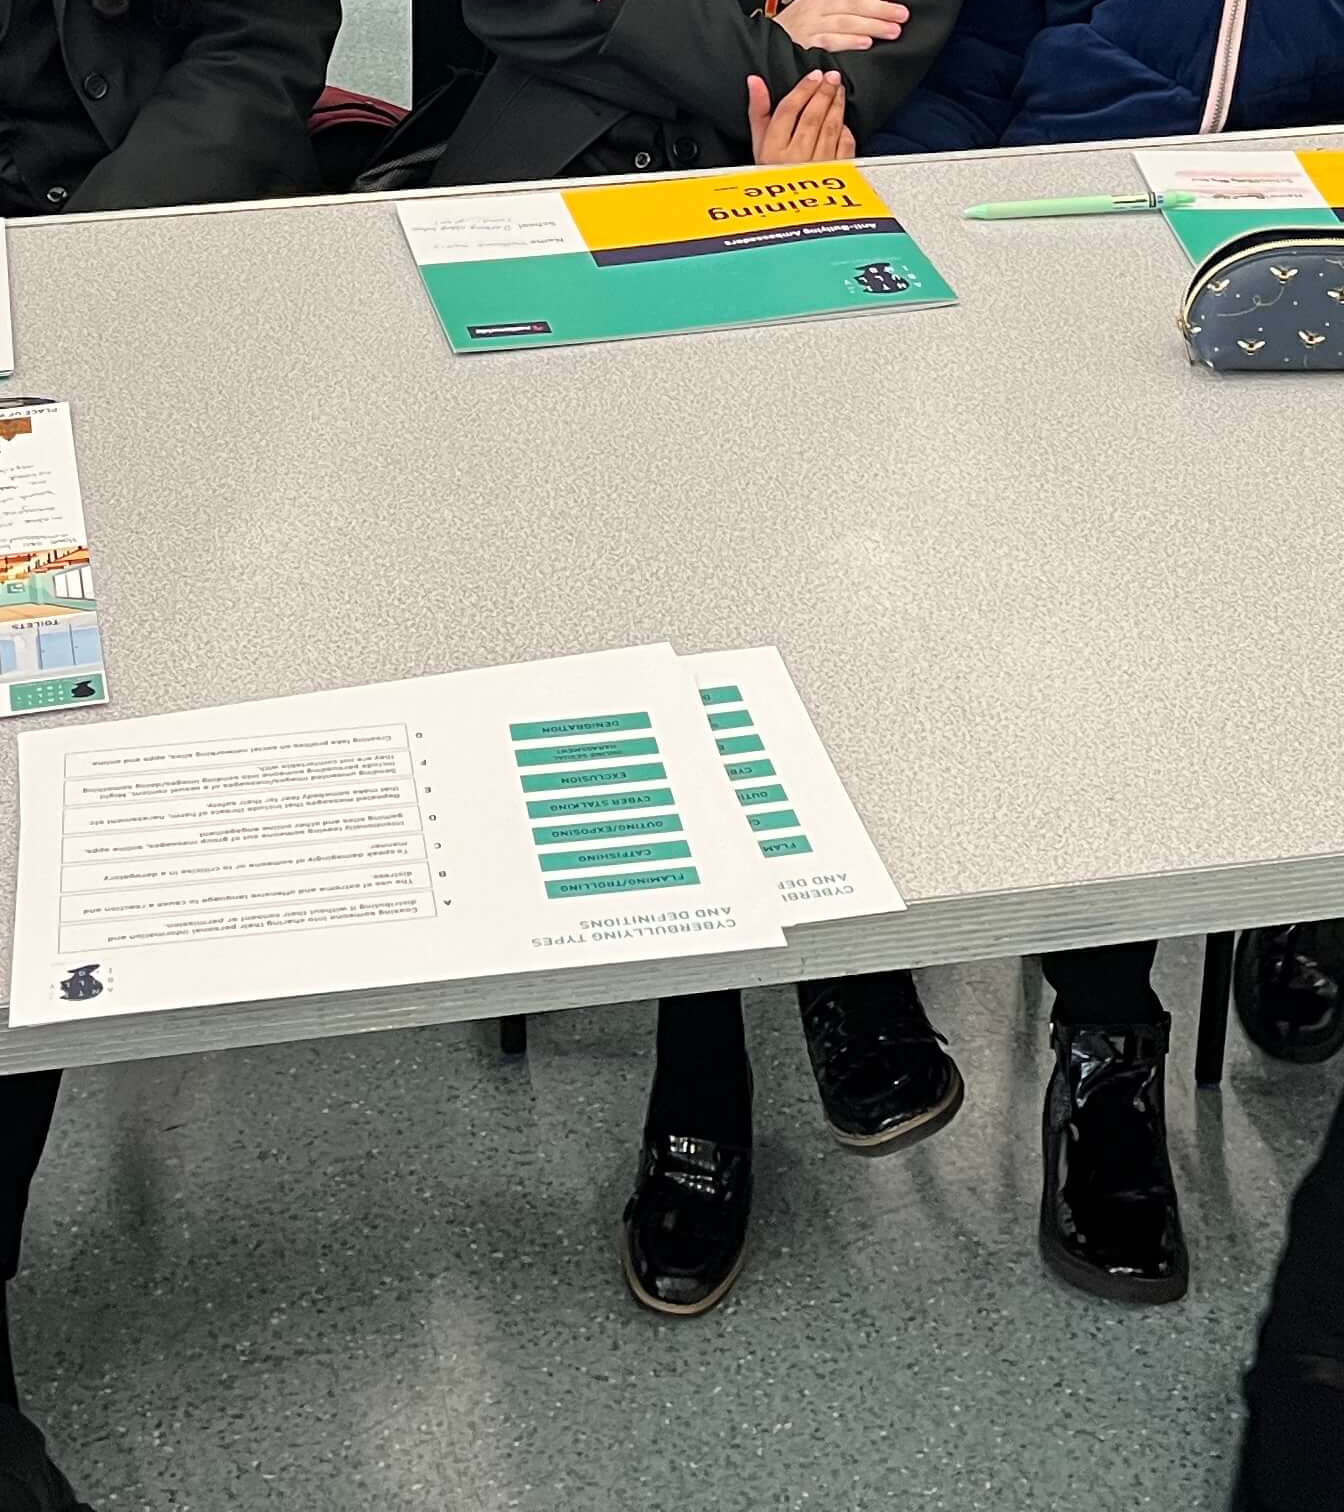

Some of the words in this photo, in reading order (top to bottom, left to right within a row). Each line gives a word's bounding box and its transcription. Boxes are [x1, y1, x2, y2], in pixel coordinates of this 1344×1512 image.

[707, 194, 862, 222] Training
[801, 222, 877, 237] Anti-Bullying
[723, 230, 801, 248] Ambassadors
[21, 407, 59, 417] PLACE
[11, 619, 59, 631] TOILETS
[541, 720, 620, 734] DENIGRATION
[560, 771, 627, 785] EXCLUSION
[549, 799, 609, 813] STALKING
[610, 795, 651, 807] CYBER
[551, 820, 664, 839] OUTING/EXPOSING
[577, 848, 652, 863] CATFISHING
[559, 873, 685, 894] FLAMING/TROLLING
[811, 872, 847, 885] AND
[694, 905, 732, 918] AND
[578, 909, 690, 930] DEFINITIONS
[591, 918, 736, 942] CYBERBULLYING
[530, 933, 587, 949] TYPES
